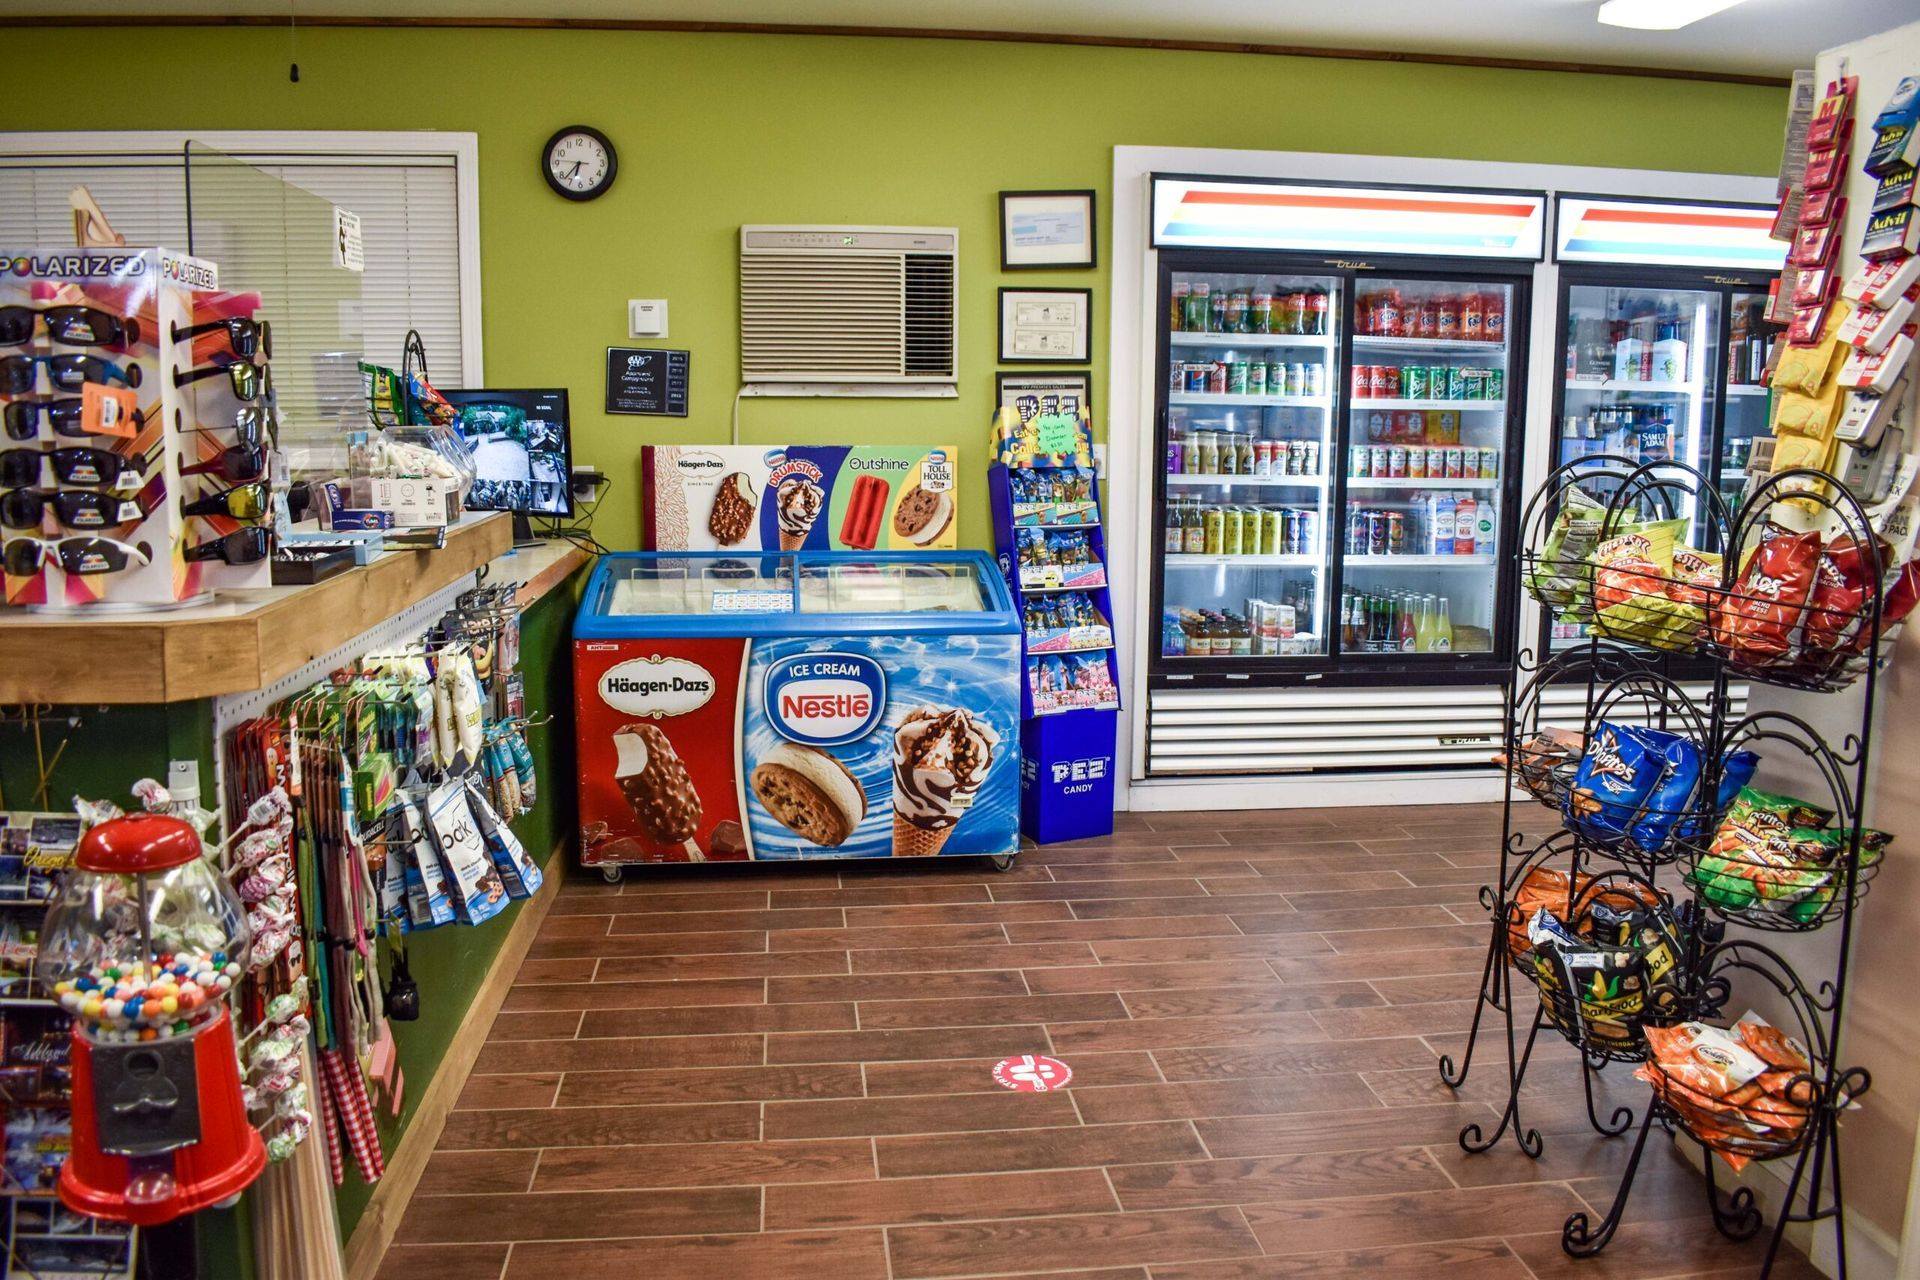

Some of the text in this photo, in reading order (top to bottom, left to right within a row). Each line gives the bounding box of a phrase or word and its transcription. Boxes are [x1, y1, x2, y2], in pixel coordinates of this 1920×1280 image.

[1870, 211, 1907, 232] Advil
[163, 257, 216, 290] POLARIZED
[849, 457, 910, 470] Outshine
[928, 465, 947, 473] TOLL
[768, 462, 823, 488] DRUMSTICK
[923, 472, 951, 480] HOUSE
[789, 663, 861, 678] ICE CREAM
[783, 694, 870, 719] Nestlé
[1051, 757, 1107, 784] PEZ
[1063, 783, 1094, 795] CANDY
